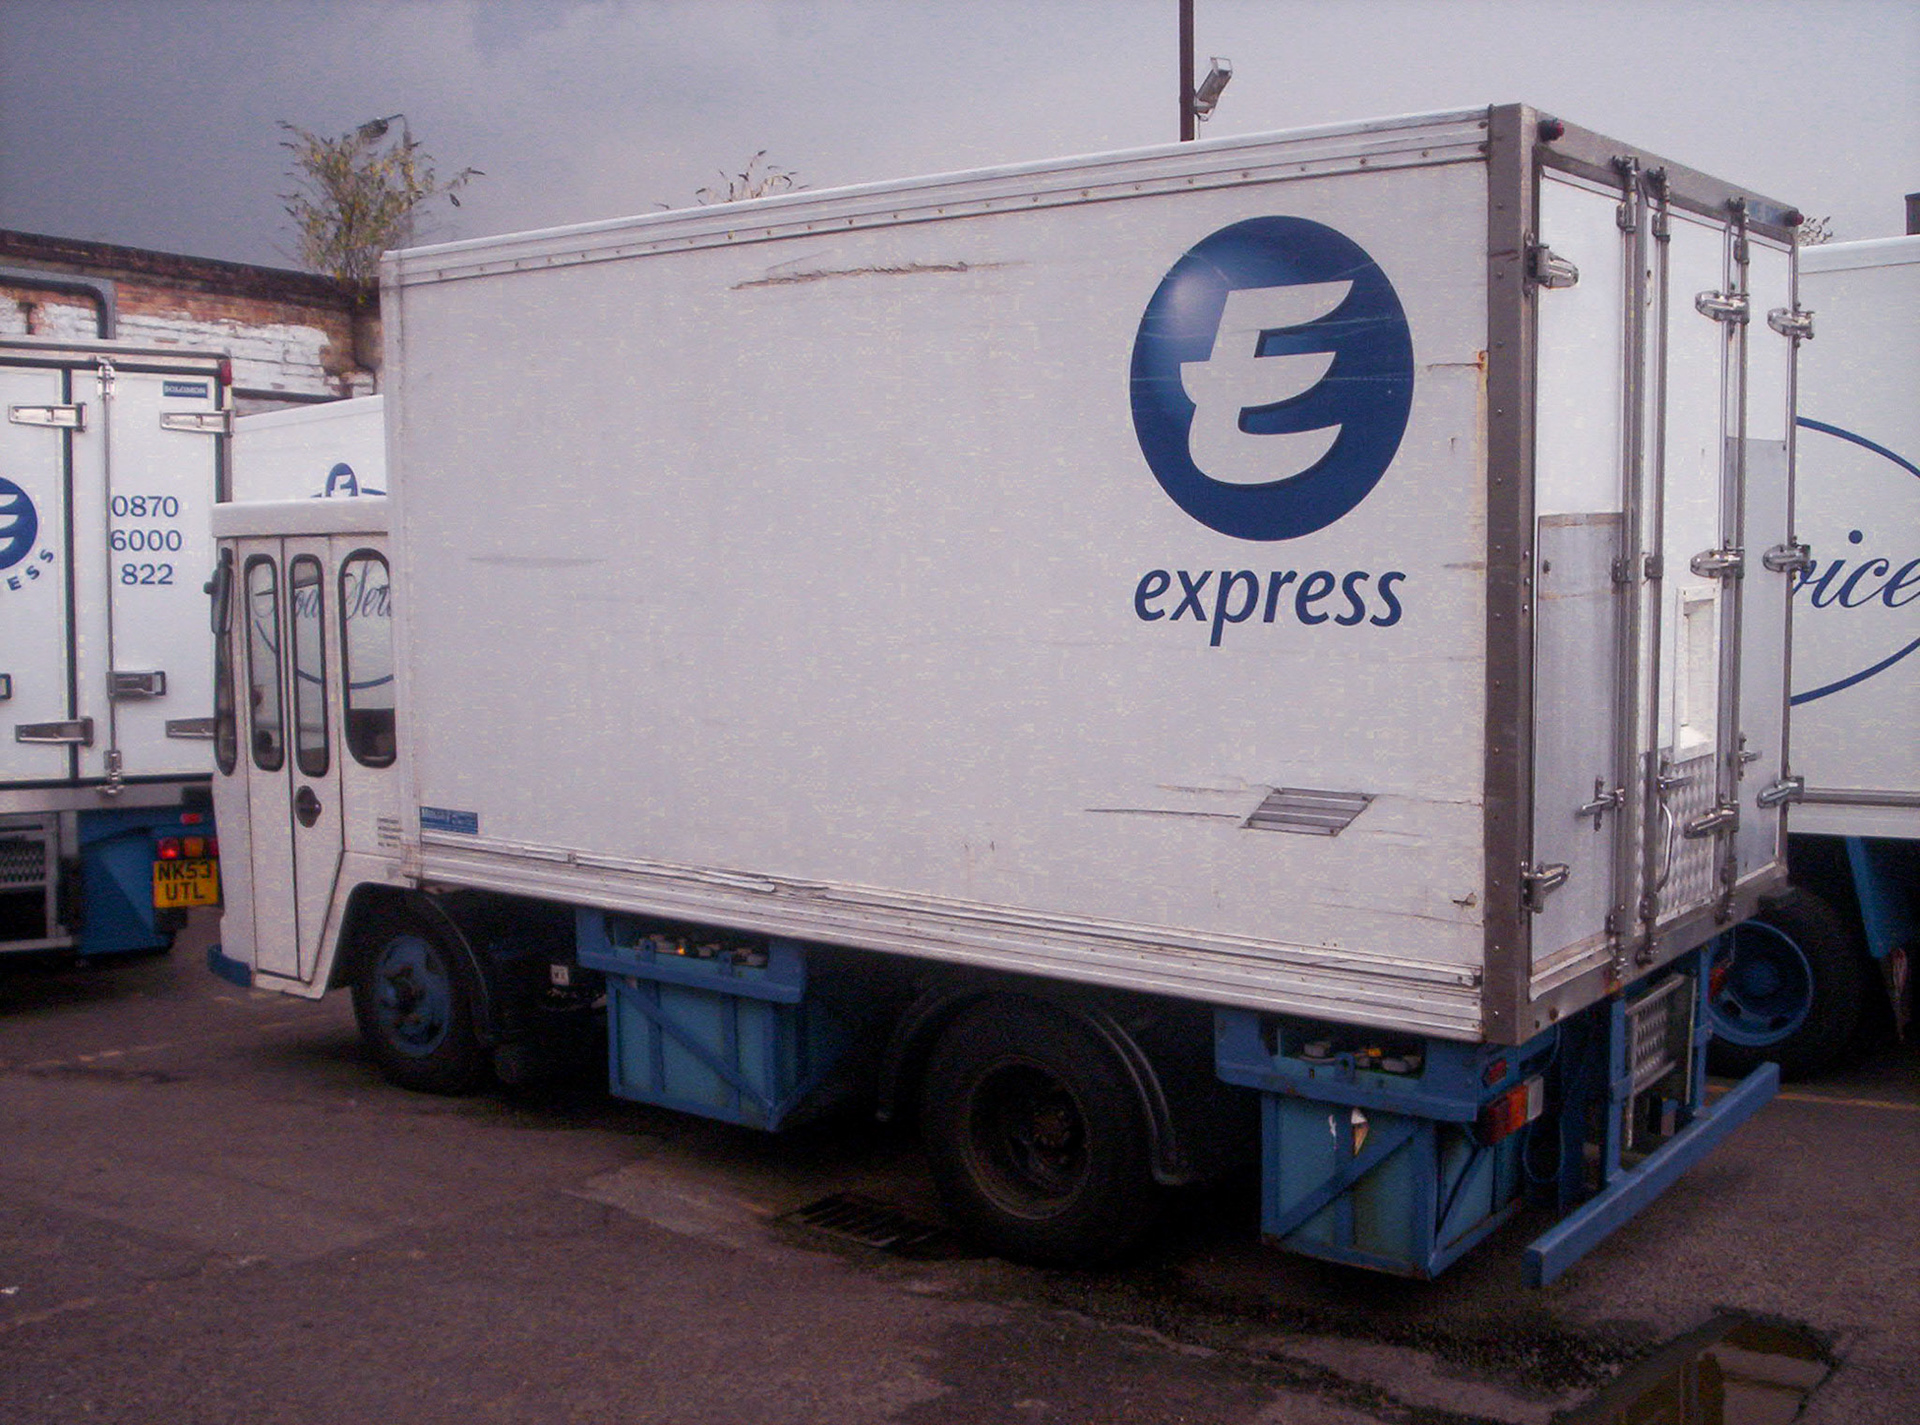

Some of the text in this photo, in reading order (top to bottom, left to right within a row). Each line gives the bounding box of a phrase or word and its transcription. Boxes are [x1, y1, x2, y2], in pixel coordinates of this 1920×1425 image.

[112, 495, 179, 517] 0870
[110, 529, 182, 551] 6000
[121, 563, 173, 585] 822
[1134, 568, 1406, 647] express
[158, 861, 209, 880] NK53
[165, 881, 205, 900] UTL
